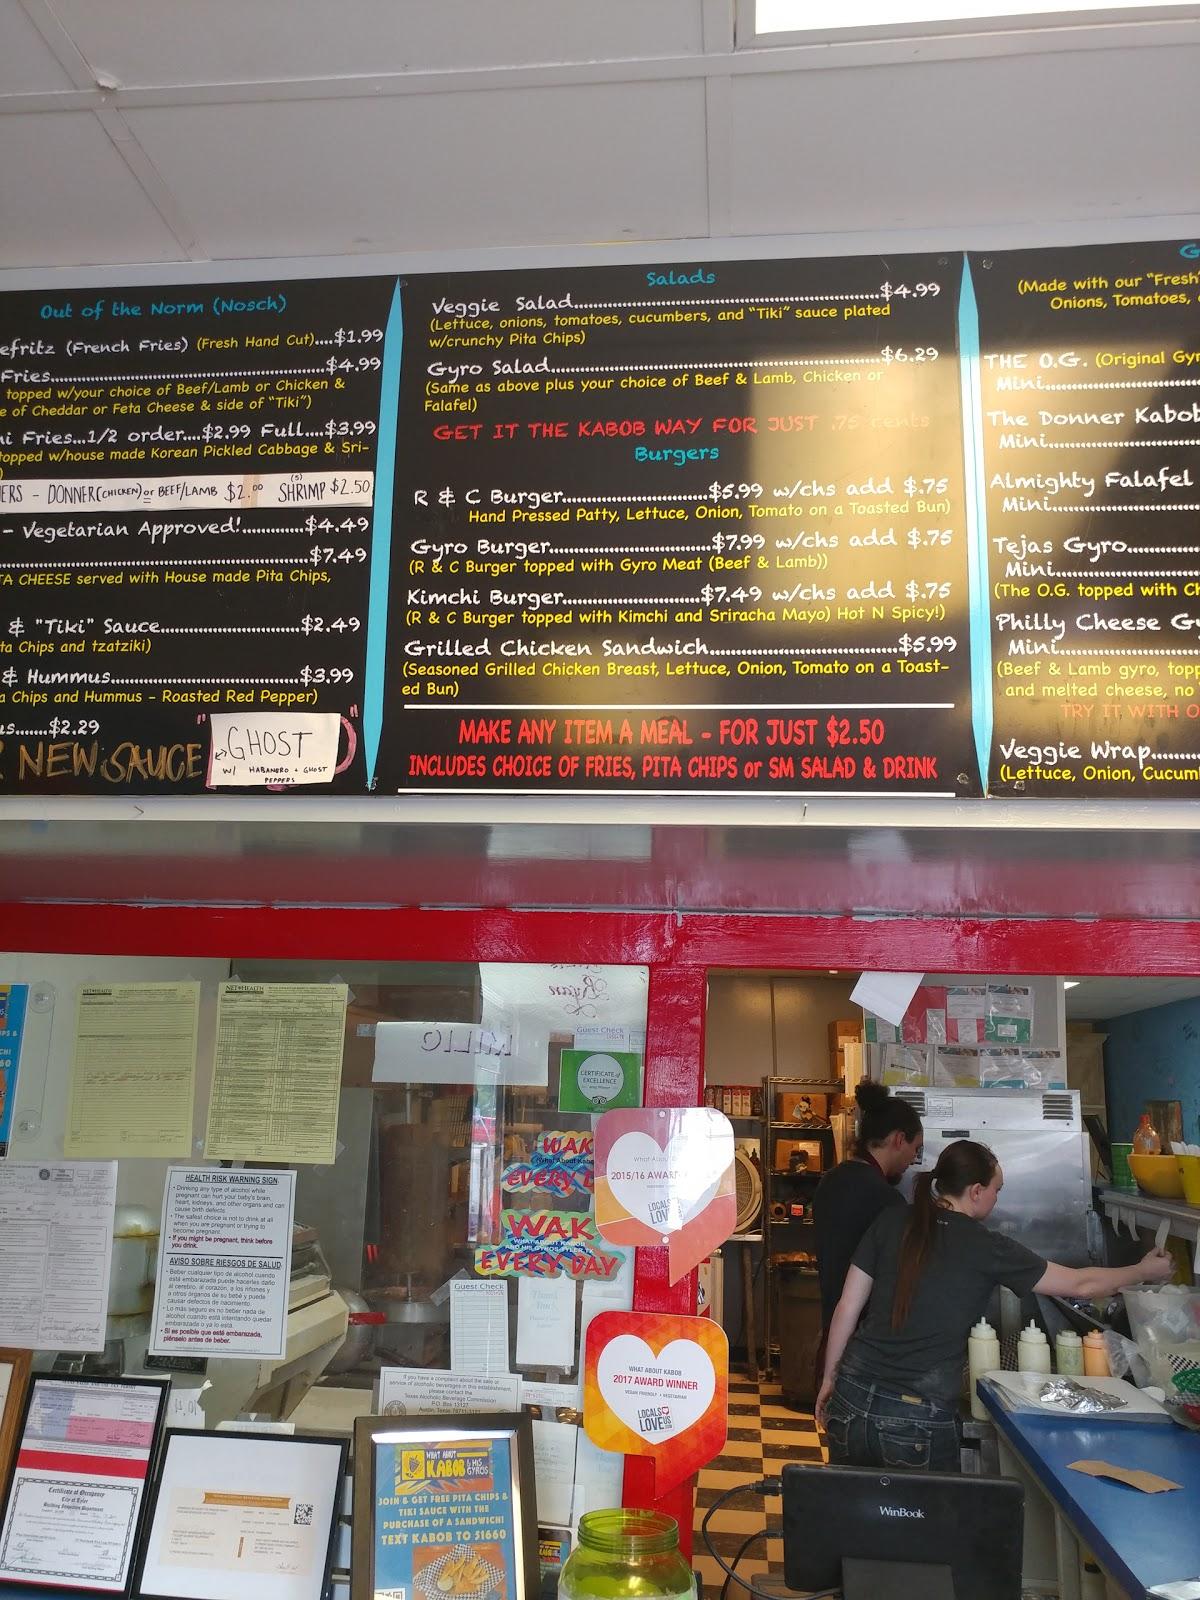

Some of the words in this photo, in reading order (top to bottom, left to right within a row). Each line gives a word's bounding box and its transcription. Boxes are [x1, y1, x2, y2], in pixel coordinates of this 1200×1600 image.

[647, 269, 716, 286] Salads
[41, 304, 72, 319] Out
[81, 302, 103, 321] of
[112, 302, 141, 317] the
[151, 299, 203, 315] Norm
[212, 295, 287, 315] (Nosch)
[432, 298, 500, 318] Veggie
[516, 293, 573, 311] Salad
[880, 282, 940, 301] $4.99
[427, 362, 483, 384] Gyro
[493, 357, 551, 374] Salad
[881, 345, 939, 365] $6.29
[984, 353, 1028, 370] THE
[1039, 352, 1088, 369] O.G.
[1095, 351, 1165, 369] (Original
[433, 424, 483, 440] GET
[493, 423, 519, 439] IT
[528, 422, 569, 438] THE
[579, 420, 646, 437] KABOB
[655, 417, 702, 434] WAY
[712, 417, 758, 434] FOR
[768, 415, 820, 432] JUST
[832, 415, 858, 431] .75
[987, 411, 1029, 426] The
[1038, 411, 1125, 426] Donner
[634, 447, 719, 466] Burgers
[990, 472, 1095, 497] Almighty
[1105, 467, 1194, 492] Falafel
[414, 490, 428, 506] R
[438, 487, 455, 507] &
[466, 489, 481, 504] C
[490, 489, 562, 509] Burger
[709, 481, 763, 503] $5.99
[773, 480, 836, 499] w/chs
[846, 481, 892, 497] add
[904, 478, 948, 498] $.75
[993, 534, 1053, 561] Tejas
[1063, 536, 1128, 562] Gyro
[8, 617, 25, 637] &
[104, 618, 160, 634] Sauce
[300, 614, 361, 636] $2.49
[995, 613, 1066, 641] Philly
[1076, 613, 1161, 631] Cheese
[2, 667, 18, 686] &
[28, 669, 111, 685] Hummus
[300, 666, 353, 687] $3.99
[459, 719, 511, 744] MAKE
[518, 719, 556, 744] ANY
[564, 719, 613, 743] ITEM
[619, 720, 633, 743] A
[641, 719, 693, 744] MEAL
[719, 719, 758, 744] FOR
[767, 719, 818, 744] JUST
[827, 715, 885, 748] $2.50
[226, 726, 312, 762] GHOST
[19, 741, 98, 780] NEW
[101, 741, 201, 783] SAUCE
[1000, 738, 1082, 765] Veggie
[1091, 740, 1151, 769] Wrap
[249, 766, 289, 774] HABANERO
[303, 765, 328, 774] GHOST
[409, 755, 486, 777] INCLUDES
[493, 755, 552, 777] CHOICE
[558, 756, 580, 777] OF
[585, 756, 635, 780] FRIES,
[643, 756, 682, 777] PITA
[688, 757, 738, 777] CHIPS
[744, 761, 762, 777] or
[769, 757, 794, 777] SM
[801, 757, 856, 778] SALAD
[863, 757, 876, 778] &
[883, 757, 938, 779] DRINK
[264, 776, 295, 784] PEPPERS
[576, 1026, 599, 1034] Guest
[601, 1026, 624, 1034] Check
[580, 1070, 614, 1078] CERTIFICATE
[543, 1137, 594, 1155] WAK
[186, 1174, 210, 1183] HEALTH
[212, 1175, 227, 1183] RISK
[229, 1175, 260, 1184] WARNING
[507, 1169, 576, 1189] EVERY
[611, 1171, 645, 1180] 2015/16
[507, 1214, 594, 1240] WAK
[191, 1258, 214, 1266] SOBRE
[216, 1259, 246, 1267] RIESGOS
[248, 1260, 257, 1268] DE
[259, 1261, 281, 1269] SALUD
[481, 1251, 563, 1273] EVERY
[572, 1255, 618, 1276] DAY
[663, 1368, 682, 1376] KABOB
[613, 1374, 632, 1384] 2017
[634, 1376, 664, 1387] AWARD
[666, 1379, 698, 1390] WINNER
[638, 1407, 662, 1419] LOCALS
[640, 1417, 664, 1432] LOVE
[664, 1416, 672, 1425] US
[426, 1451, 441, 1460] WHAT
[443, 1451, 457, 1459] ABOUT
[427, 1459, 465, 1478] KABOB
[472, 1458, 483, 1467] HIS
[467, 1466, 488, 1475] GYROS
[378, 1497, 400, 1506] JOIN
[403, 1496, 409, 1504] &
[411, 1495, 428, 1504] GET
[431, 1495, 450, 1503] FREE
[452, 1494, 472, 1502] PITA
[475, 1492, 499, 1501] CHIPS
[502, 1492, 508, 1500] &
[399, 1508, 417, 1516] TIKI
[420, 1507, 447, 1515] SAUCE
[450, 1506, 471, 1514] WITH
[474, 1504, 490, 1513] THE
[879, 1506, 925, 1519] WinBook
[383, 1519, 430, 1529] PURCHASE
[432, 1519, 444, 1527] OF
[446, 1518, 453, 1526] A
[381, 1534, 409, 1545] TEXT
[412, 1532, 453, 1544] KABOB
[456, 1531, 471, 1541] TO
